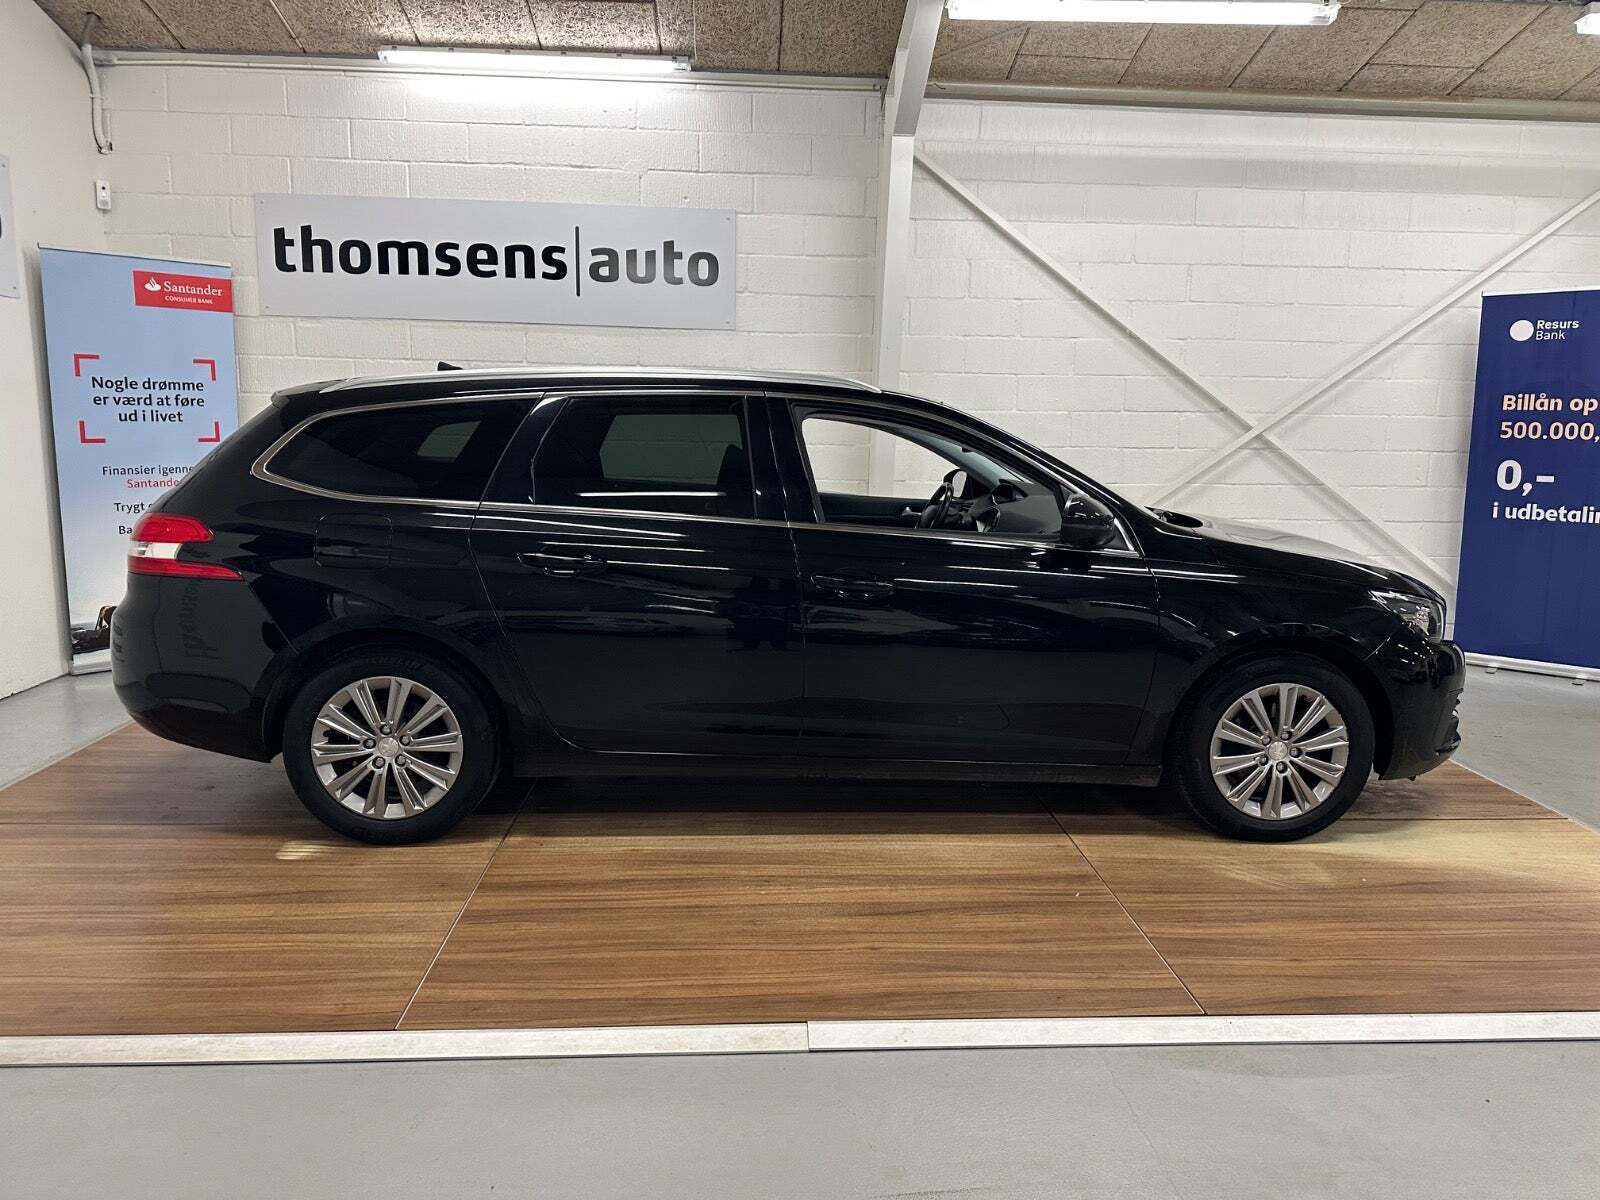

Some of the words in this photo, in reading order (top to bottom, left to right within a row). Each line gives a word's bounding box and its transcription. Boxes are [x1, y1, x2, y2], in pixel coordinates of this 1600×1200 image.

[273, 224, 567, 281] thomsens
[588, 239, 719, 287] auto
[163, 280, 223, 297] Santander
[197, 297, 213, 305] BANK
[1536, 319, 1579, 330] Resurs
[1535, 329, 1566, 340] Bank
[91, 376, 138, 392] Nogle
[142, 377, 204, 391] drømme
[93, 395, 107, 405] er
[113, 393, 152, 406] værd
[156, 397, 171, 406] at
[175, 394, 205, 407] føre
[1502, 392, 1563, 411] Billån
[1569, 398, 1598, 416] op
[118, 409, 138, 422] ud
[142, 410, 146, 422] i
[150, 410, 184, 422] livet
[102, 465, 155, 476] Finansier
[113, 502, 145, 514] Trygt
[1492, 501, 1499, 519] i
